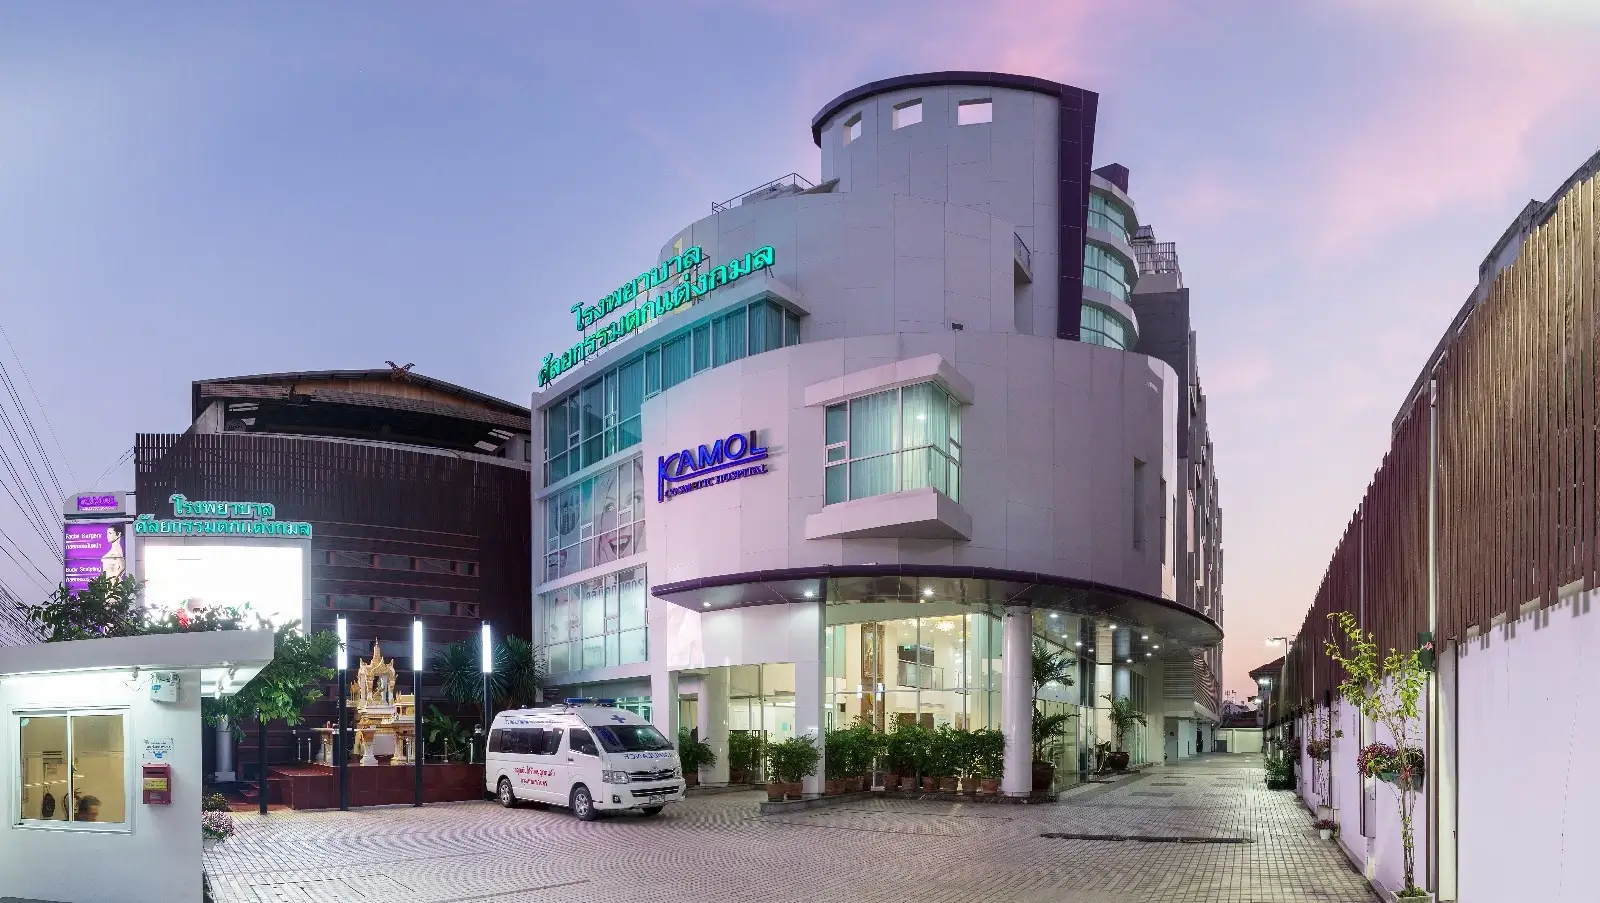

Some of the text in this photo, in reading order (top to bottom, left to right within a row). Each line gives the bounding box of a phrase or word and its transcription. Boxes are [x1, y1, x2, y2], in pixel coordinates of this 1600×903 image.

[571, 245, 702, 331] โรงพยาบาล
[538, 245, 775, 387] ศัลยกรรมตกแต่งกมล
[657, 430, 768, 503] KAMOL
[665, 463, 769, 498] COSMETIC HOSPITAL
[135, 515, 311, 536] ศัลยกรรมตกแต่งกมล
[171, 495, 273, 517] โรงพยาบาล
